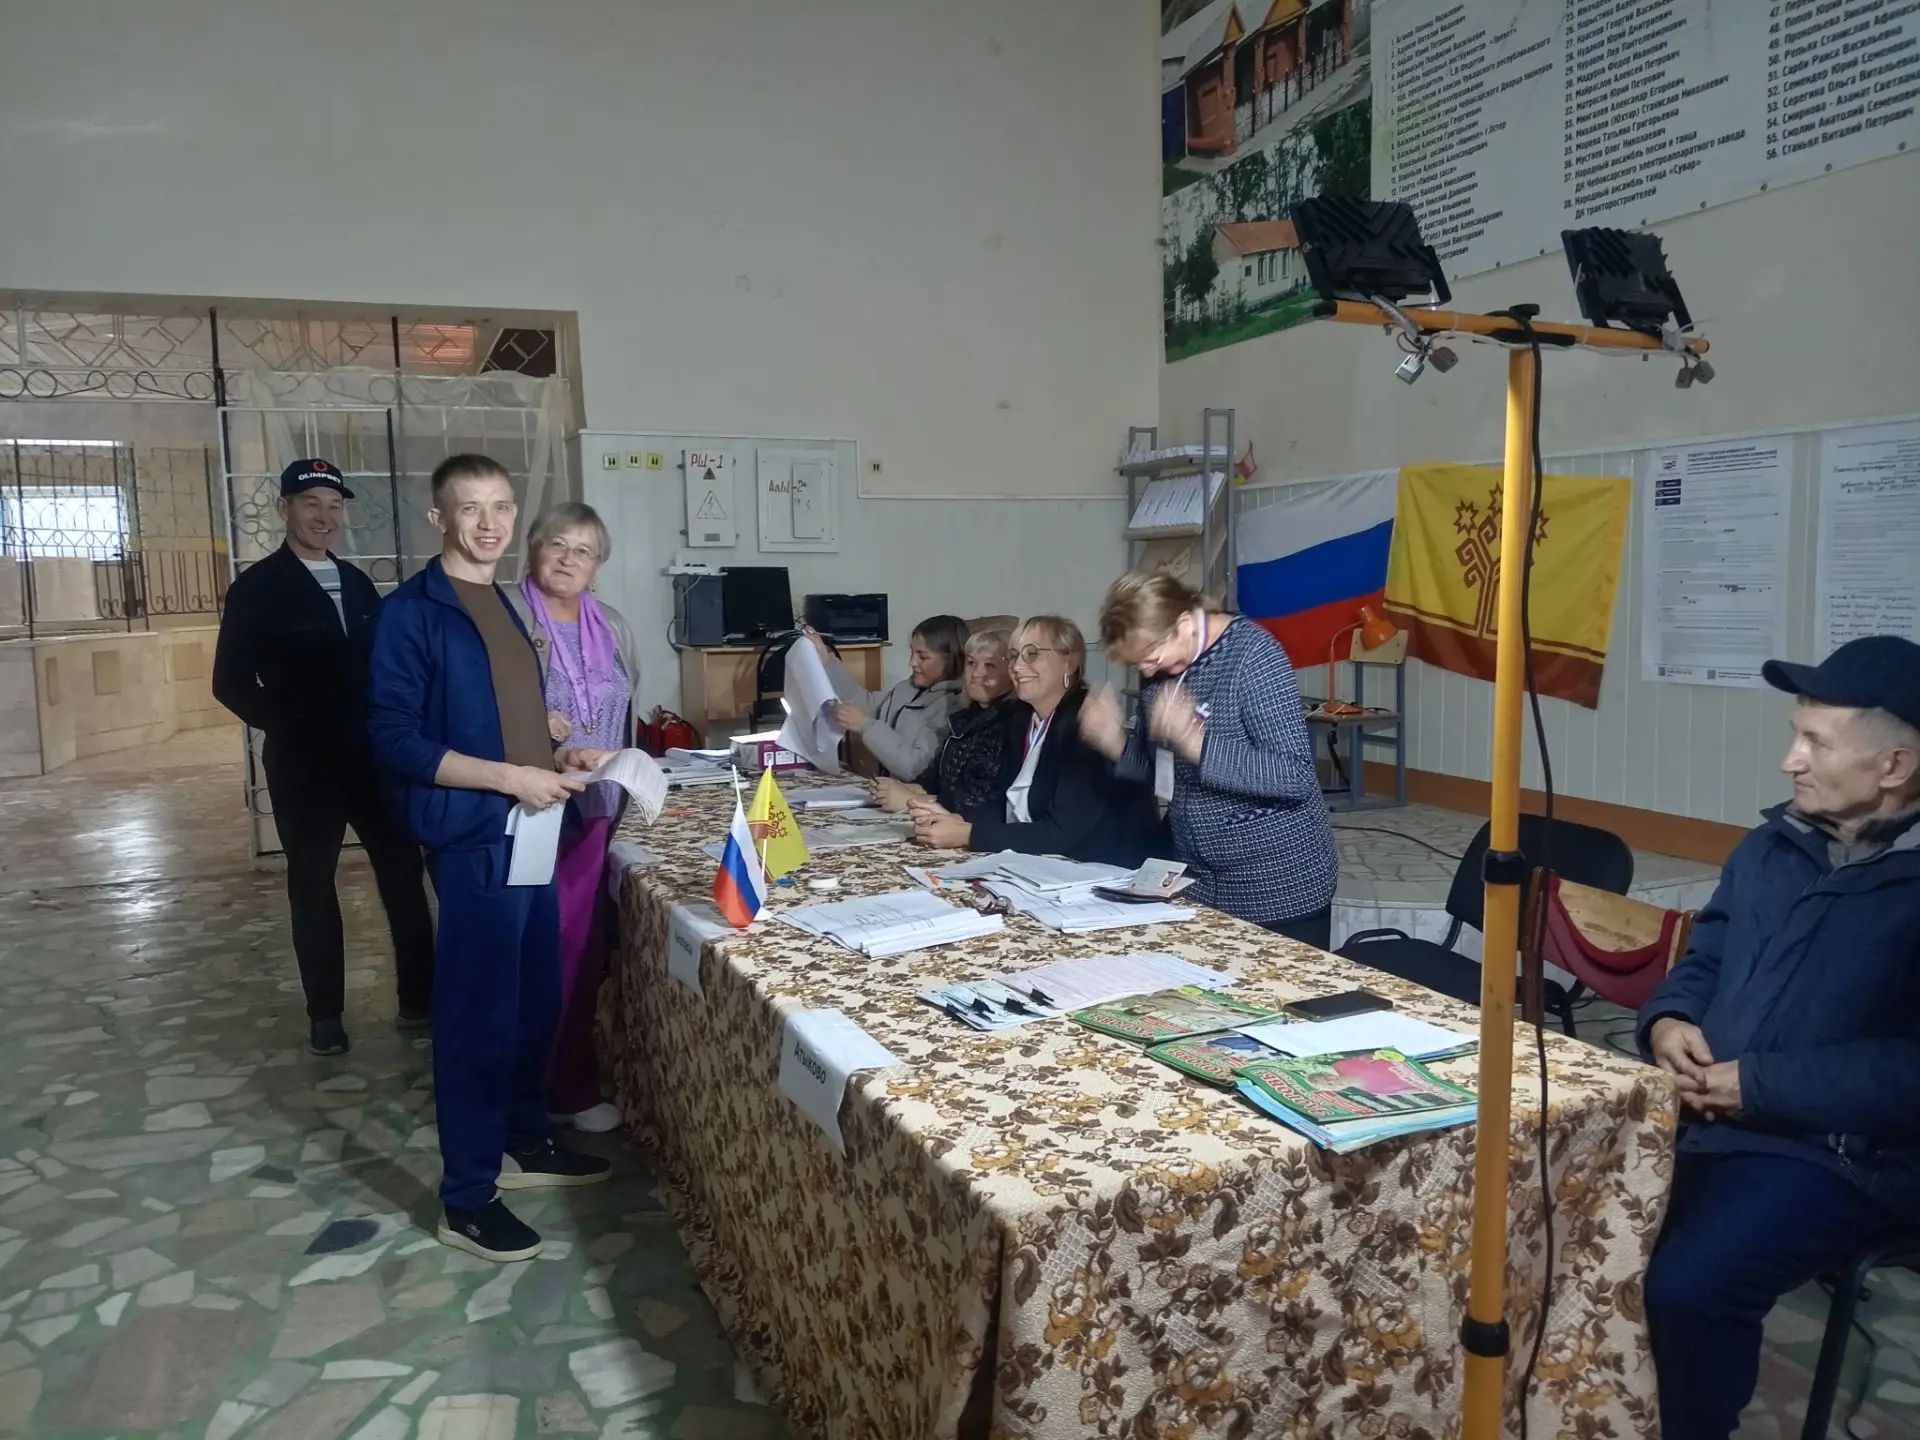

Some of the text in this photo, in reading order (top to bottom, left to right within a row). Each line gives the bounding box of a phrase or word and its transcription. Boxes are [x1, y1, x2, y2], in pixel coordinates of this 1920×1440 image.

[1769, 7, 1781, 19] 47.
[1769, 22, 1781, 35] 48.
[1768, 38, 1781, 51] 49.
[1768, 54, 1781, 66] 50.
[1767, 70, 1779, 82] 51.
[1767, 85, 1781, 98] 52.
[1767, 102, 1779, 113] 53.
[1766, 117, 1779, 129] 54.
[1766, 133, 1779, 145] 55.
[1766, 149, 1779, 160] 56.
